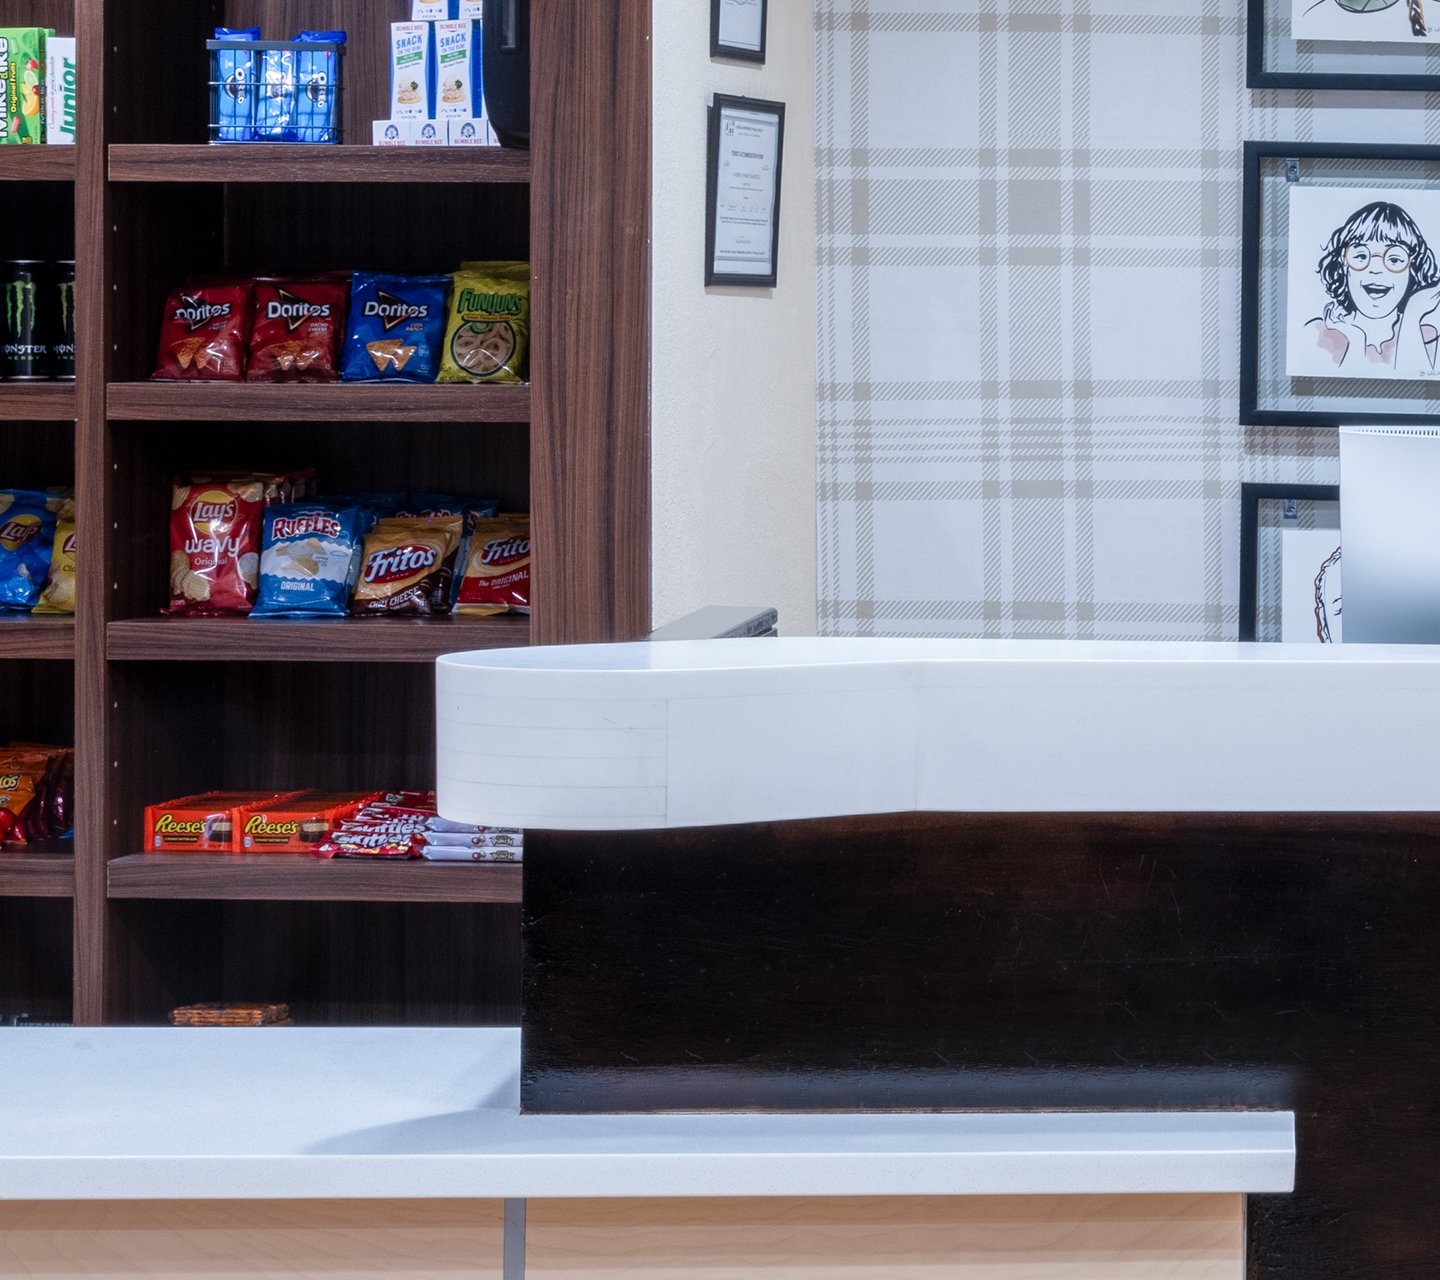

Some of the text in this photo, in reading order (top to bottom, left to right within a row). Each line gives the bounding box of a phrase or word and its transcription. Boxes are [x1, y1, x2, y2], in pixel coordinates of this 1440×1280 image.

[396, 34, 422, 49] SNACK
[440, 32, 466, 48] SNACK
[235, 67, 245, 104] OREO
[317, 71, 327, 108] OREO
[60, 56, 76, 142] Junior
[268, 301, 330, 318] Doritos
[364, 301, 428, 318] Doritos
[272, 517, 340, 540] RUFFLES
[185, 536, 240, 557] wavy
[482, 538, 530, 564] Frito
[365, 546, 436, 583] Fritos
[281, 581, 315, 591] ORIGINAL
[491, 570, 529, 586] ORIGINAL
[390, 587, 421, 606] CHEESE
